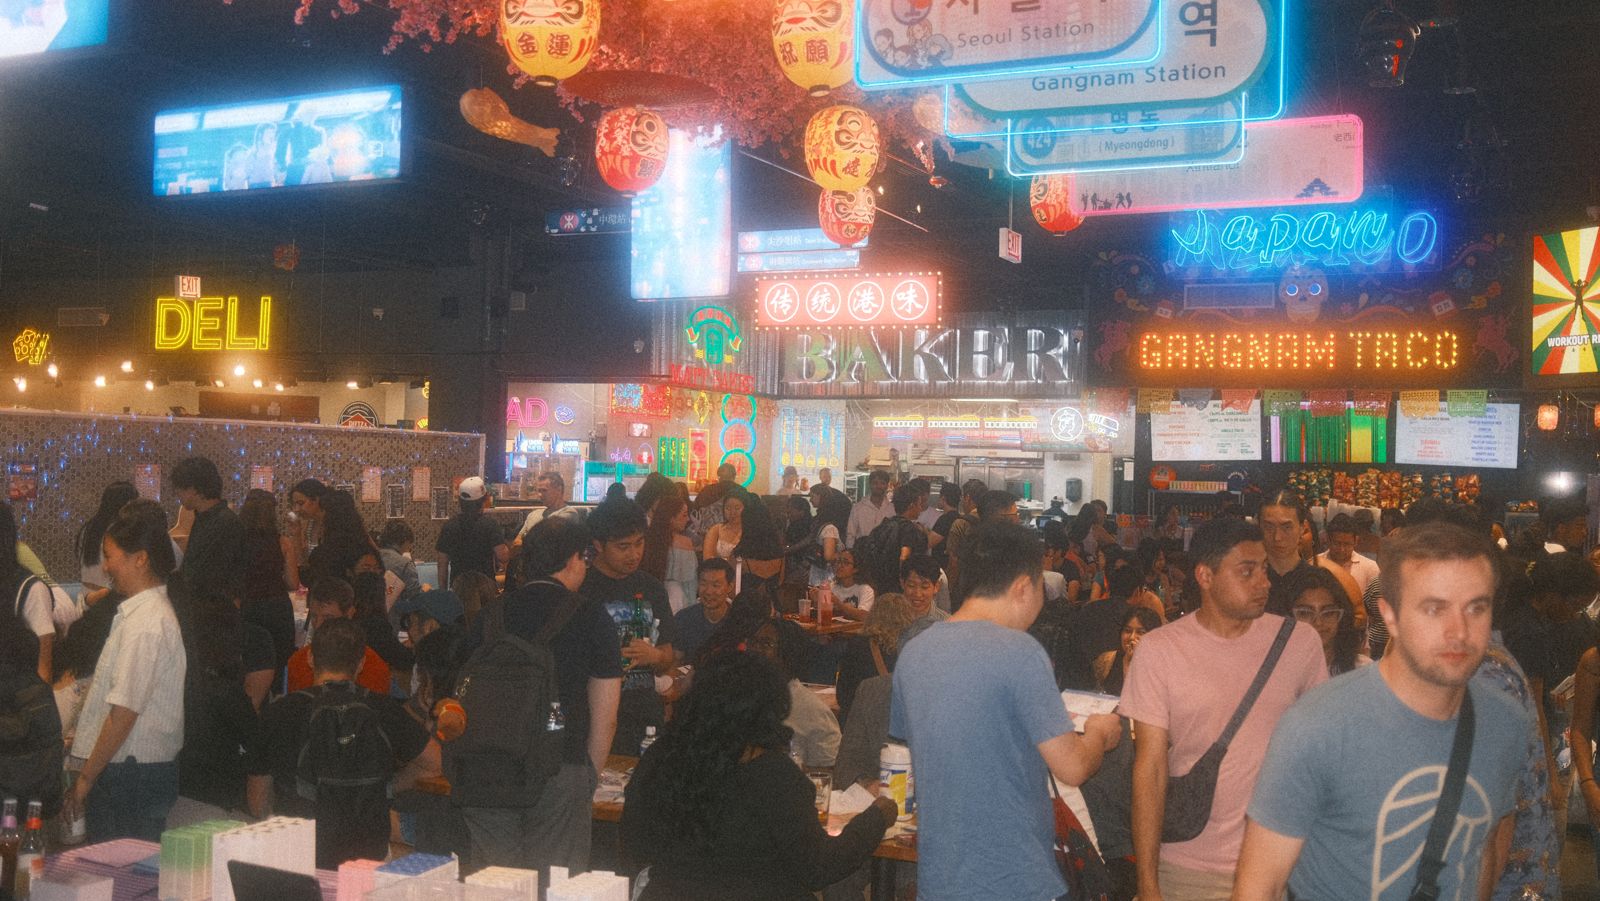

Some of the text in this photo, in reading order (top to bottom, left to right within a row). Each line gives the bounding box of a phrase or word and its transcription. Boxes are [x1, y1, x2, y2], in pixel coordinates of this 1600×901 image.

[957, 22, 1095, 48] Seoul Station
[1032, 63, 1226, 92] Gangnam Station
[181, 276, 199, 292] EXIT
[769, 283, 924, 316] 传统港味
[155, 296, 271, 350] DELI
[782, 328, 1075, 384] BAKER
[1138, 329, 1459, 369] GANGNAM TACO
[1547, 334, 1600, 348] WORKOUT R
